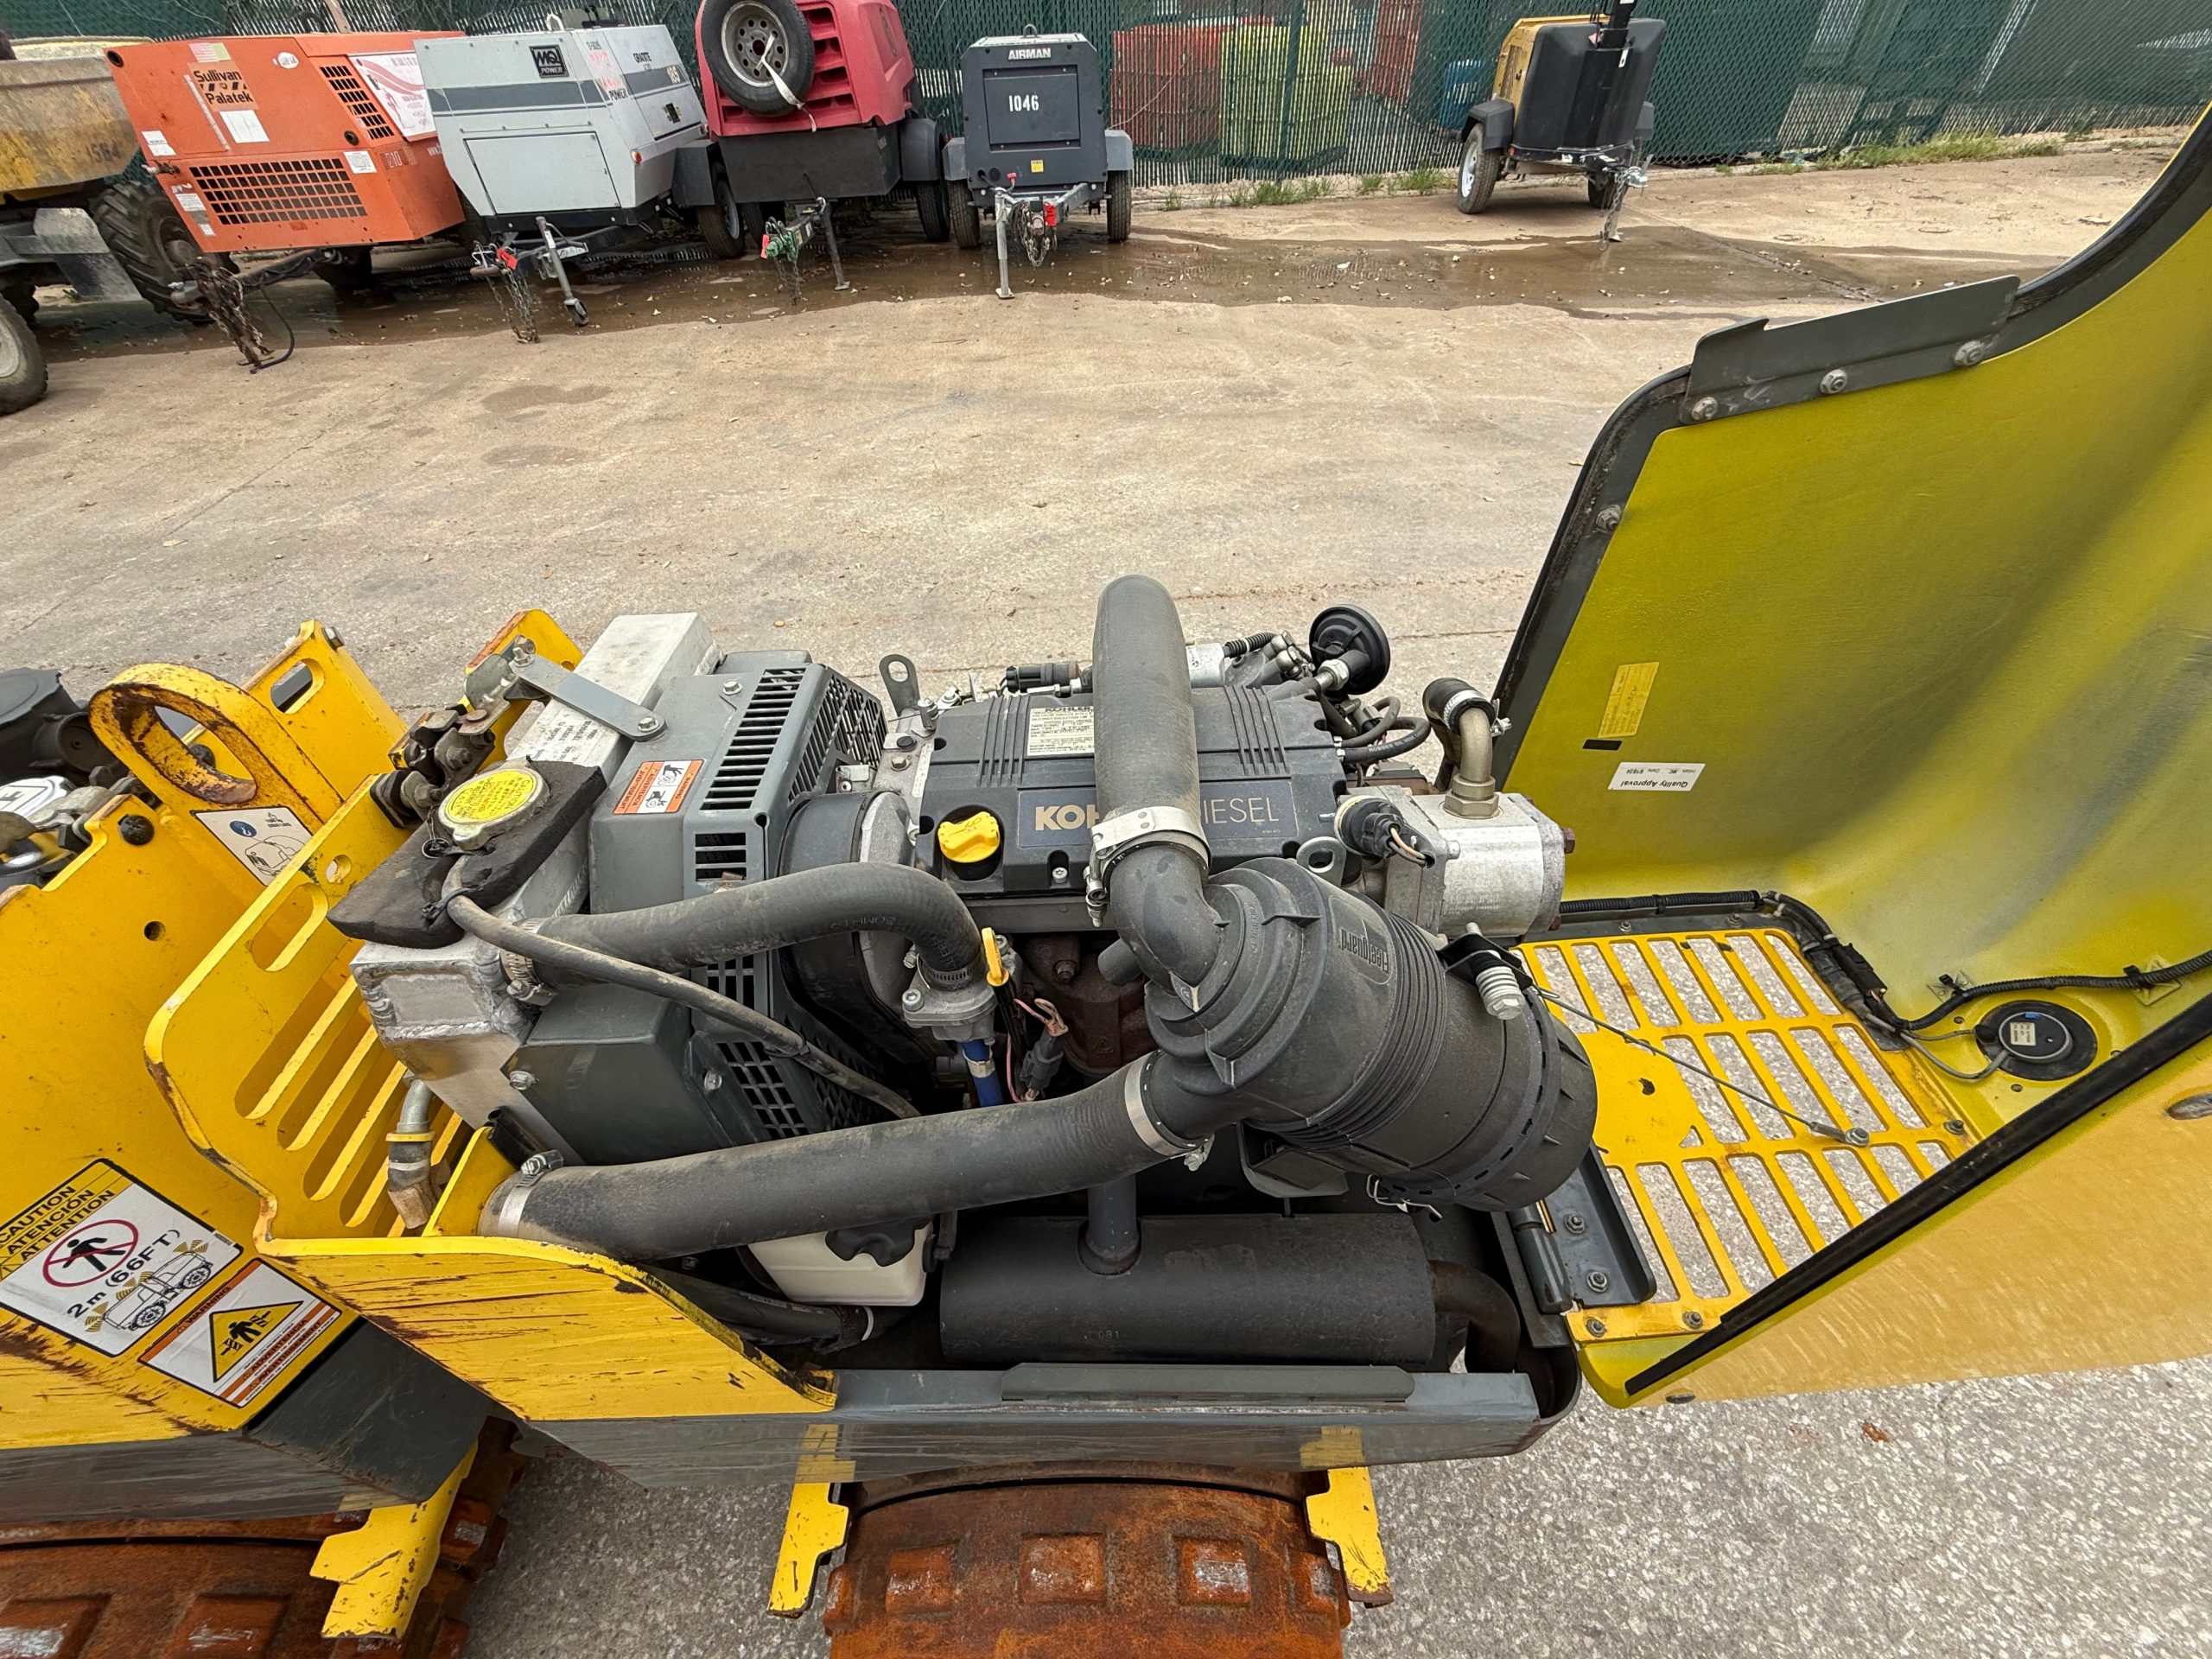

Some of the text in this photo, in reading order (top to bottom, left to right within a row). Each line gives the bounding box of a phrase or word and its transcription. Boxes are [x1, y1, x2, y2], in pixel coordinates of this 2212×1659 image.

[533, 48, 562, 67] MQ
[1007, 48, 1052, 60] AIRMAN
[194, 69, 243, 83] Sullivan
[205, 91, 254, 105] Palatek
[608, 88, 628, 101] POWER
[1008, 94, 1039, 112] 1046
[1620, 779, 1688, 788] Quality Approval
[1204, 797, 1280, 824] IESEL
[0, 1185, 77, 1243] CAUTION
[7, 1189, 95, 1255] ATENCIÓN
[20, 1189, 116, 1262] ATTENTION
[185, 1286, 232, 1325] WARNING
[251, 1319, 309, 1371] ADVERTENCIA
[257, 1320, 321, 1382] AVERTISSEMENT
